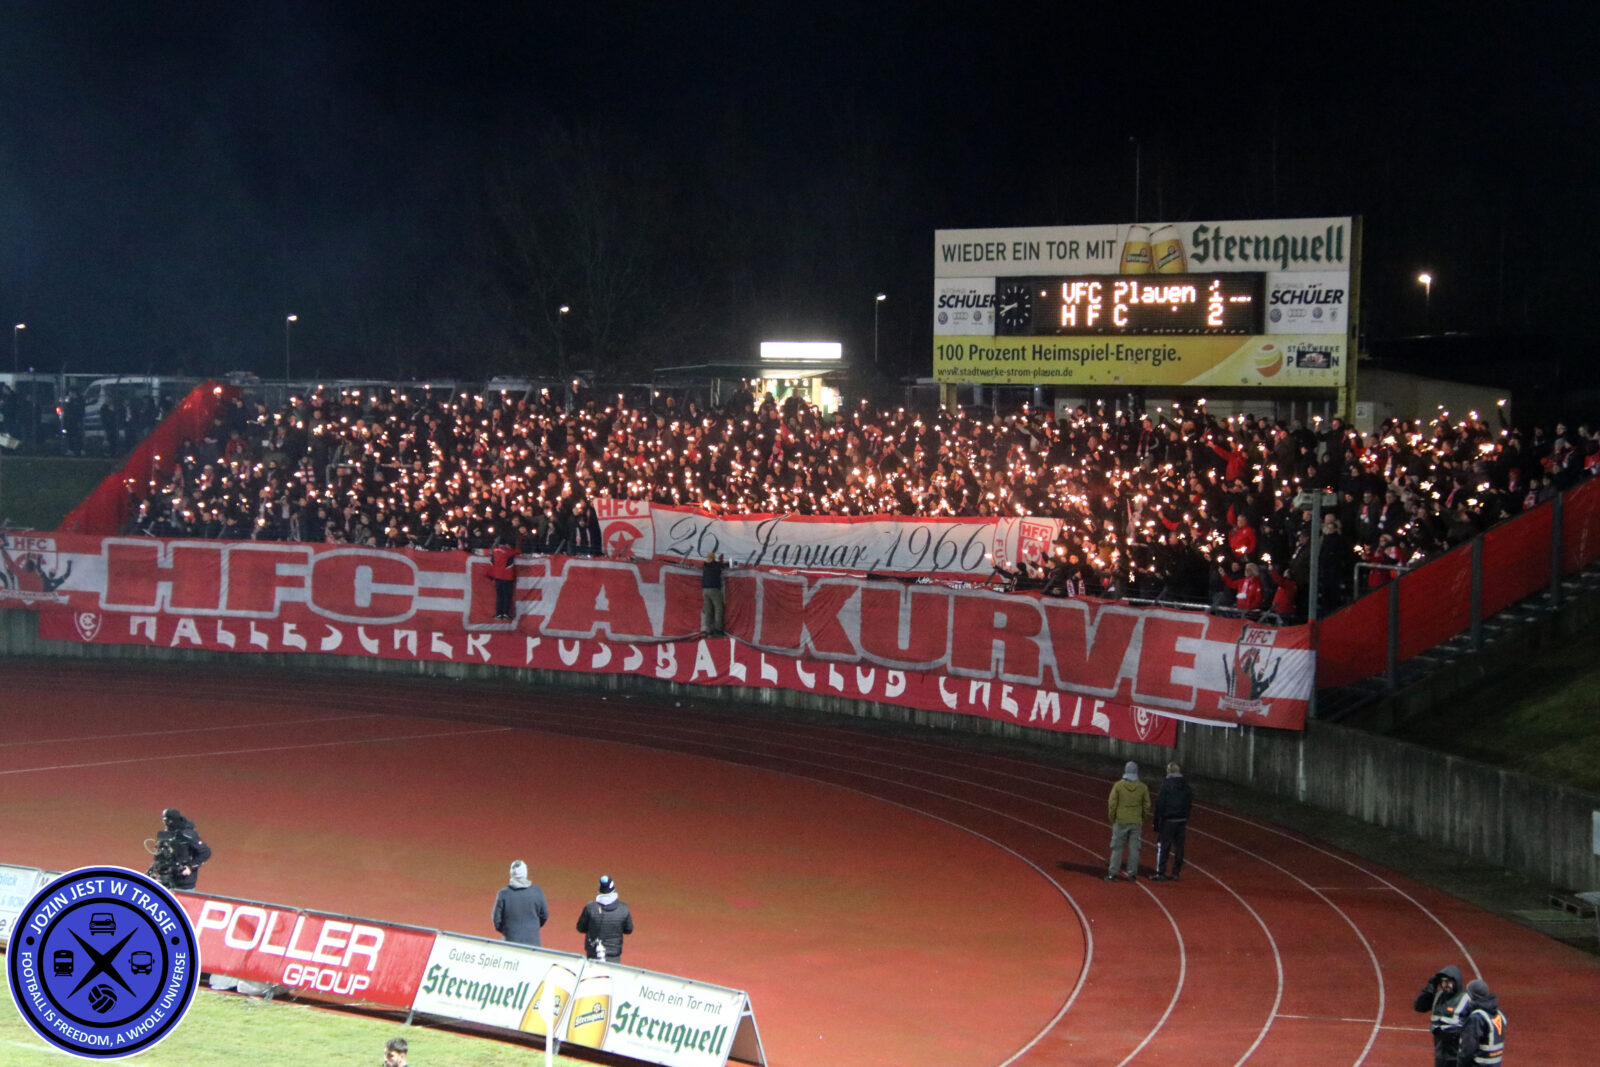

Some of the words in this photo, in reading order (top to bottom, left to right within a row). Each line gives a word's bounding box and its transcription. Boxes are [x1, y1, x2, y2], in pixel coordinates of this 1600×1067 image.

[942, 242, 1006, 262] WIEDER
[1012, 241, 1040, 261] EIN
[1046, 240, 1080, 260] TOR
[1086, 239, 1117, 260] MIT
[1190, 223, 1344, 271] Sternquell
[1061, 281, 1102, 305] VFC
[1112, 280, 1197, 305] Plauen
[1269, 283, 1345, 305] SCHÜLER
[1207, 302, 1225, 327] 2
[937, 343, 965, 361] 100
[968, 343, 1028, 361] Prozent
[1031, 342, 1182, 367] Heimspiel-Energie.
[1287, 344, 1340, 353] STADTWERKE
[937, 366, 1074, 379] www.stadtwerke-strom-plauen.de
[597, 497, 640, 518] HFC
[14, 537, 48, 550] HFC
[668, 516, 720, 559] 26
[752, 512, 869, 569] Januar
[880, 522, 991, 572] 1966
[1021, 524, 1049, 540] HFC
[1246, 629, 1272, 644] HFC
[194, 900, 385, 973] POLLER
[448, 947, 476, 964] Gutes
[477, 952, 503, 969] Spiel
[502, 959, 520, 972] mit
[282, 963, 371, 996] GROUP
[422, 963, 530, 1011] Sternquell
[638, 984, 665, 1003] Noch
[667, 992, 684, 1006] ein
[687, 994, 703, 1010] Tor
[703, 1001, 722, 1015] mit
[610, 1000, 728, 1057] Sternquell
